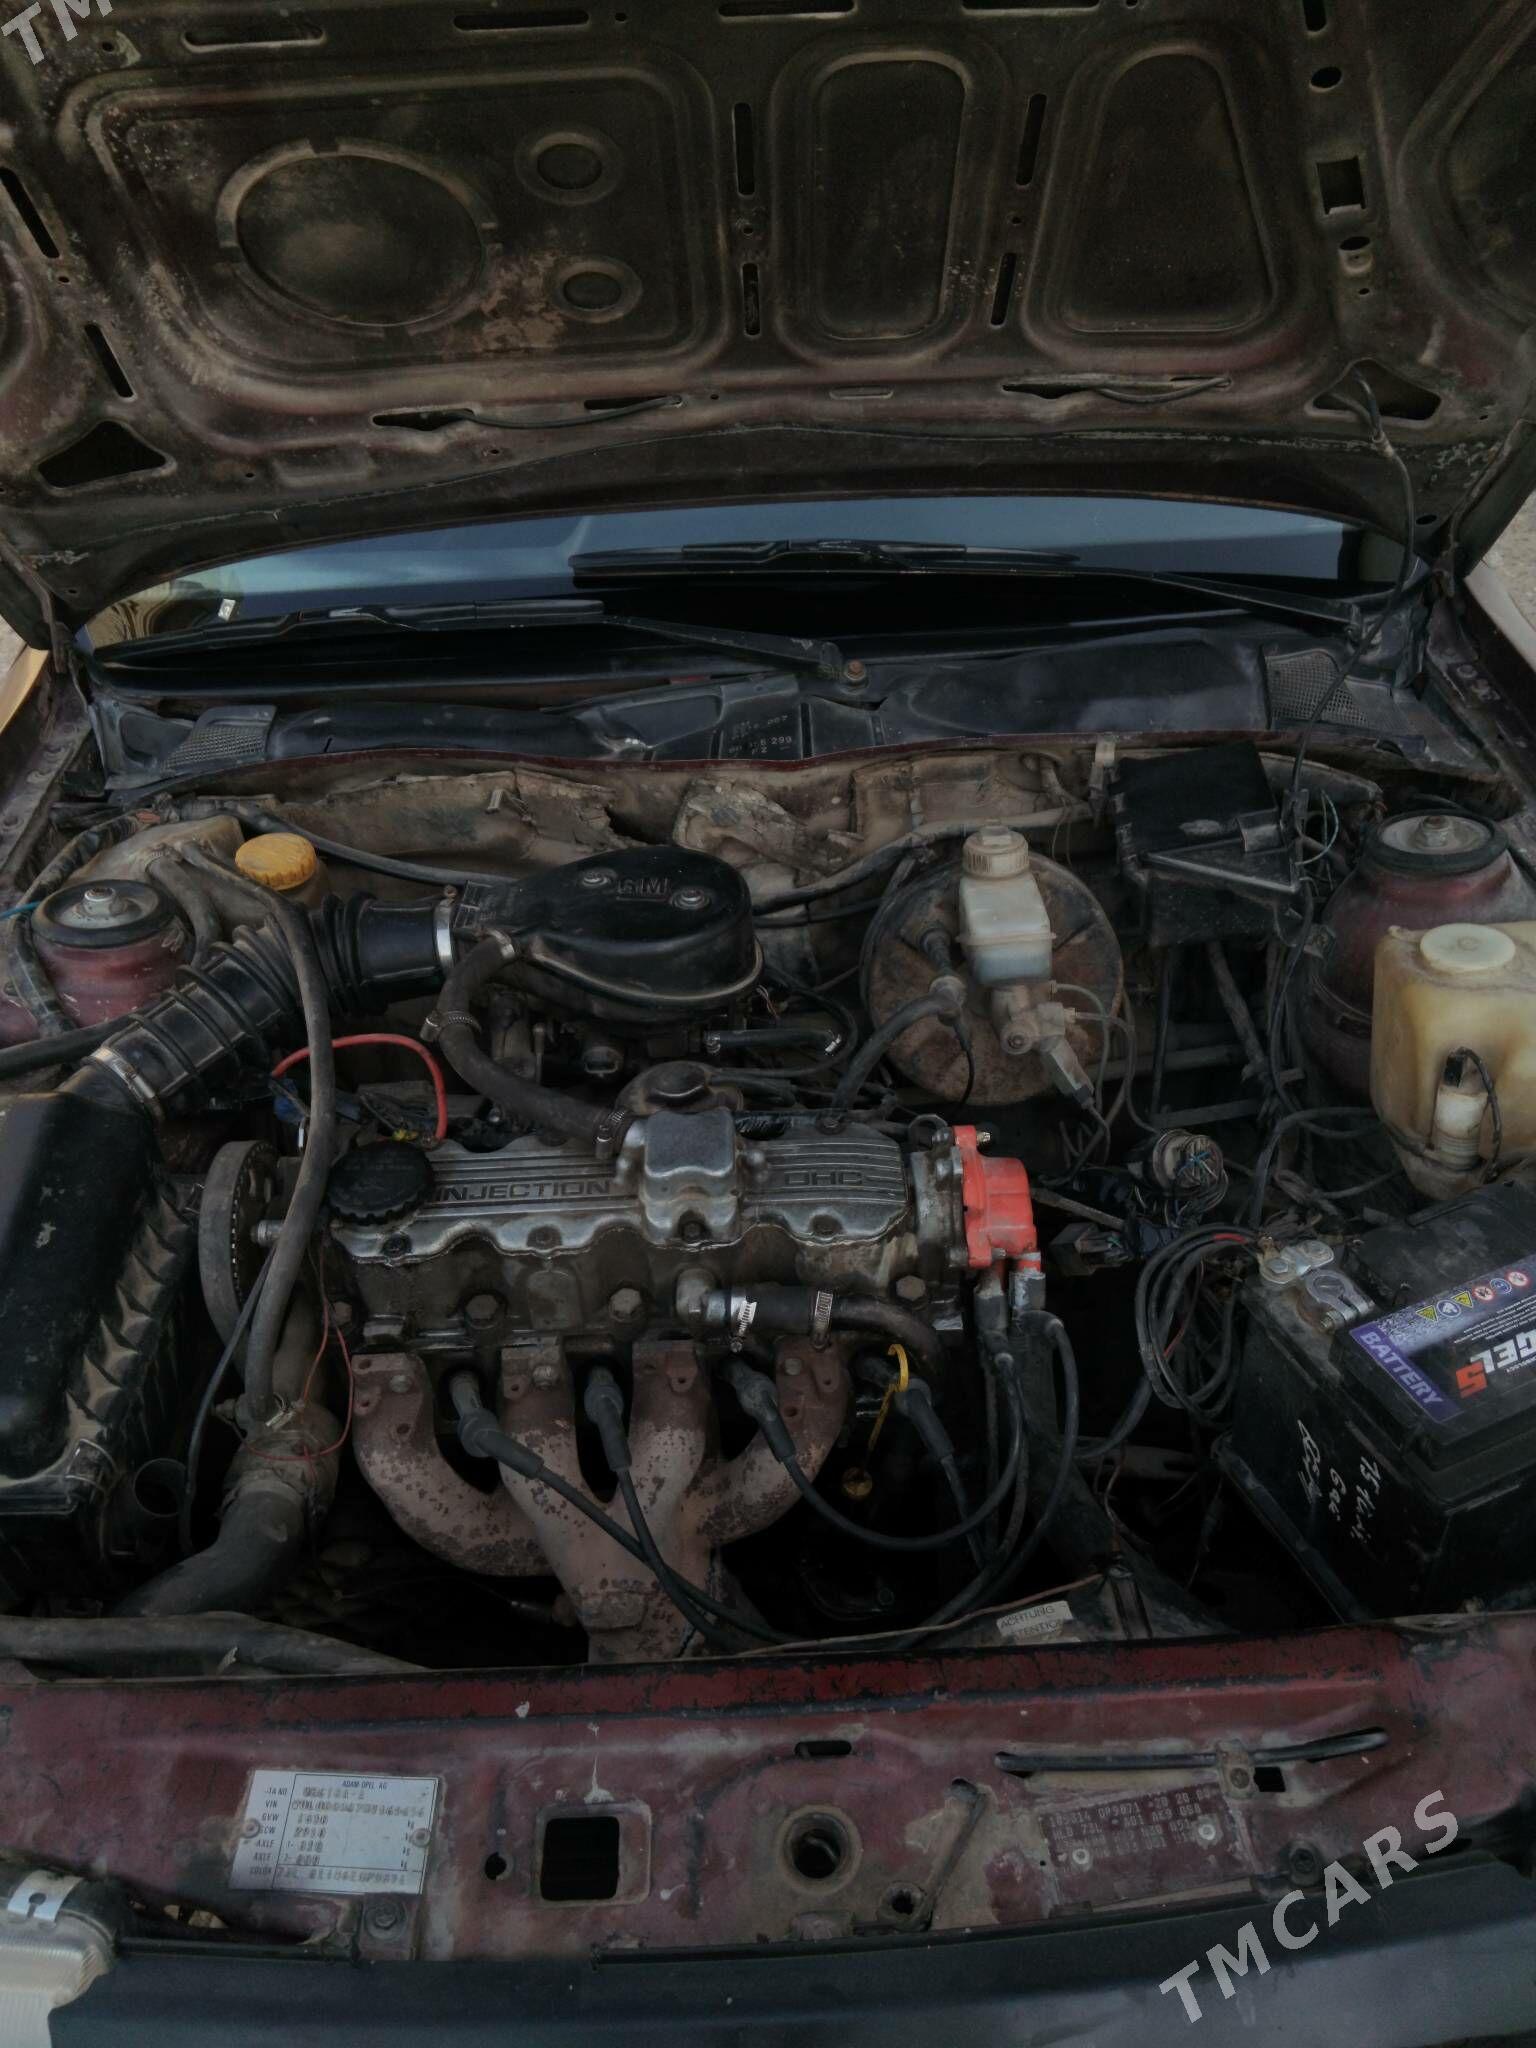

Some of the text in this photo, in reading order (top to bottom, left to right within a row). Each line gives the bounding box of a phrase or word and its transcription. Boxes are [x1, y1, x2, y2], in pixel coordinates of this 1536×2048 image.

[785, 1170, 864, 1186] OHC
[435, 1180, 611, 1201] INJECTION
[1360, 1332, 1443, 1404] BATTERY
[1000, 1605, 1055, 1628] ACHTUNG
[265, 1800, 277, 1809] VIN
